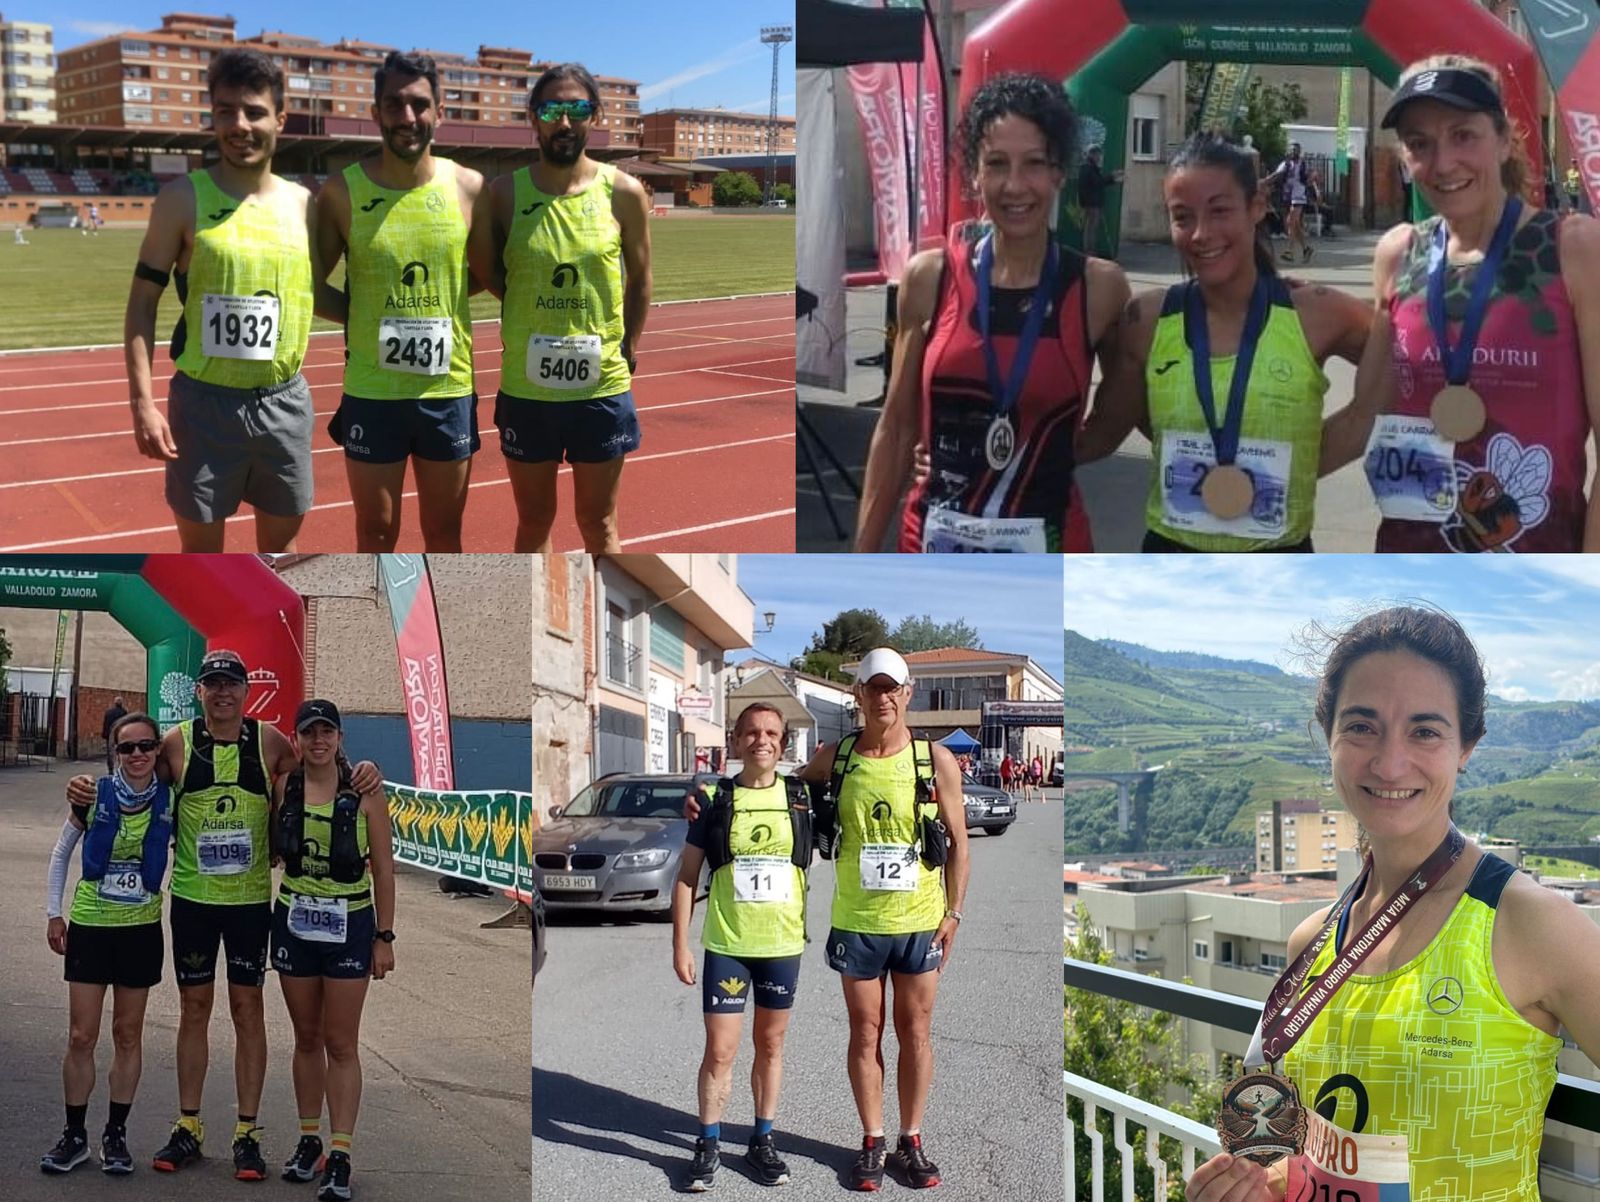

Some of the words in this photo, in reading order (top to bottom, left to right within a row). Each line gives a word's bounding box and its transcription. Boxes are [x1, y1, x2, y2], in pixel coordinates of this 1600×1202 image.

[385, 295, 441, 309] Adarsa
[535, 295, 588, 309] Adarsa
[209, 312, 273, 348] 1932
[385, 336, 445, 368] 2431
[540, 357, 590, 381] 5406
[1373, 446, 1426, 483] 204
[5, 584, 56, 598] VALLADOLID
[60, 586, 98, 599] ZAMORA
[202, 817, 244, 830] Adarsa
[213, 844, 240, 860] 109
[876, 861, 901, 880] 12
[117, 873, 137, 889] 48
[546, 876, 570, 888] 6953
[574, 877, 593, 888] HDY
[750, 873, 771, 891] 11
[1386, 892, 1412, 918] MEIA
[303, 910, 332, 926] 103
[1347, 913, 1393, 961] MARATONA
[1324, 958, 1354, 989] DOURO
[1283, 987, 1330, 1039] VINHATEIRO
[1404, 1032, 1473, 1048] Mercedes-Benz
[1420, 1047, 1454, 1059] Adarsa
